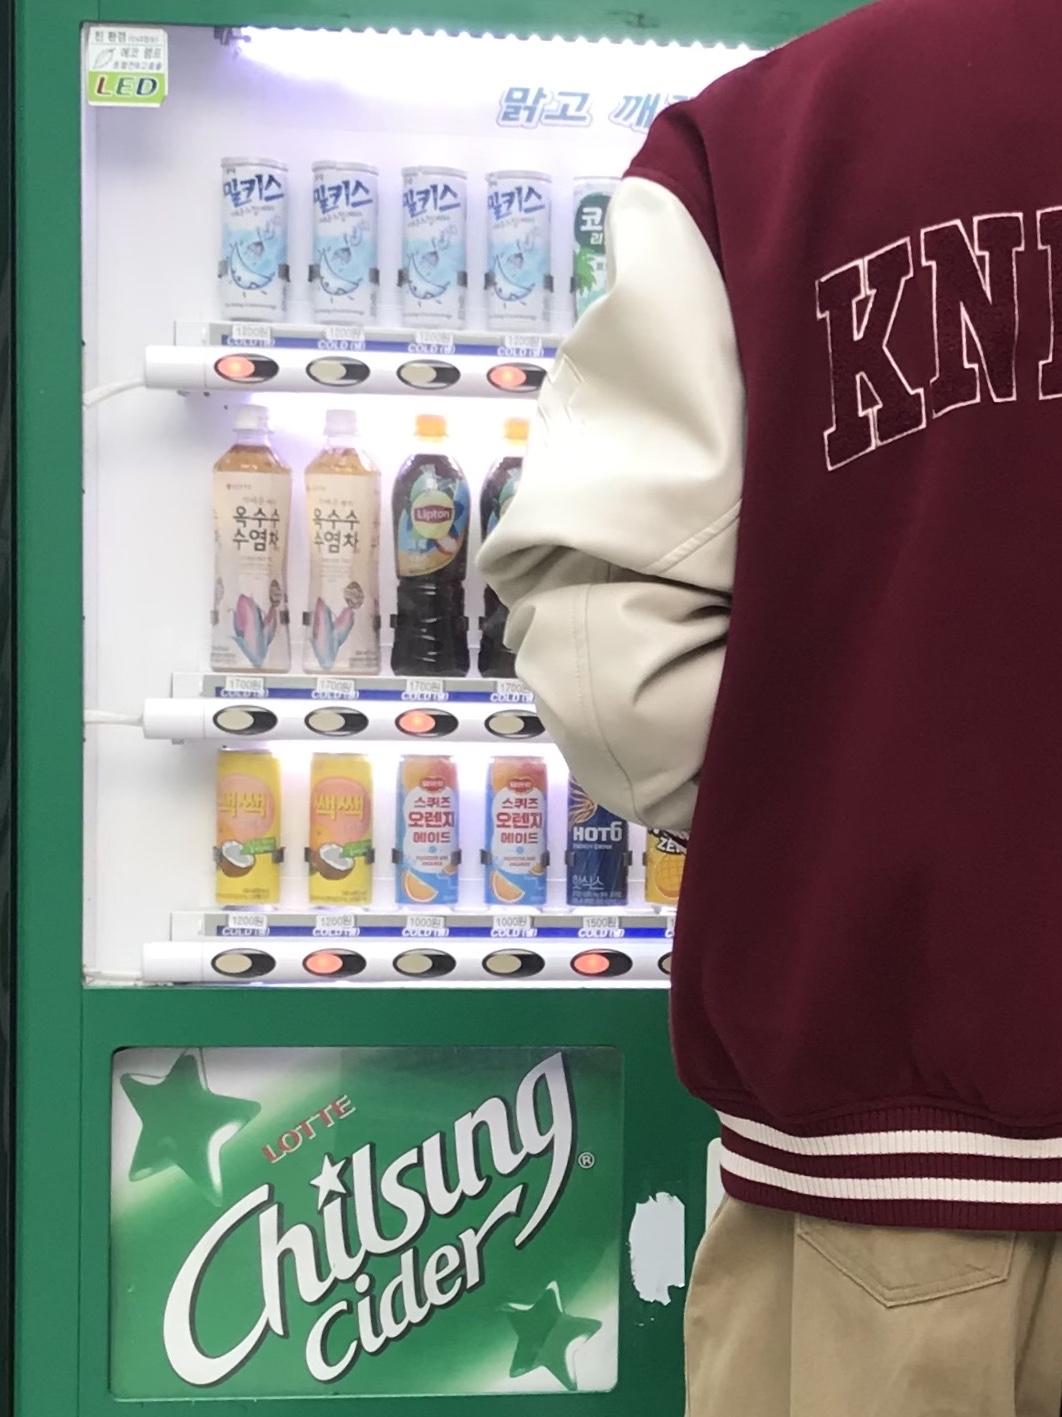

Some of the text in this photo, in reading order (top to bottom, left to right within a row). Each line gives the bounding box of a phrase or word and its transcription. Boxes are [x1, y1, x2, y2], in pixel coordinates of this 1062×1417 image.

[97, 76, 158, 96] LED
[500, 86, 591, 125] 맑고
[223, 173, 285, 208] 밀키스
[313, 179, 373, 215] 밀키스
[402, 184, 461, 219] 밀키스
[488, 186, 546, 221] 밀키스
[233, 506, 280, 528] 옥수수
[312, 508, 360, 530] 옥수수
[416, 509, 450, 521] Lipton
[233, 528, 280, 551] 수염차
[314, 530, 360, 553] 수염차
[414, 797, 451, 808] 스퀴즈
[502, 798, 538, 809] 스퀴즈
[408, 811, 455, 828] 오렌지
[496, 812, 542, 829] 오렌지
[413, 831, 451, 843] 에이드
[501, 832, 538, 844] 에이드
[586, 918, 617, 928] 1500원
[261, 1094, 356, 1165] LOTTE
[163, 1051, 577, 1386] Chilsung
